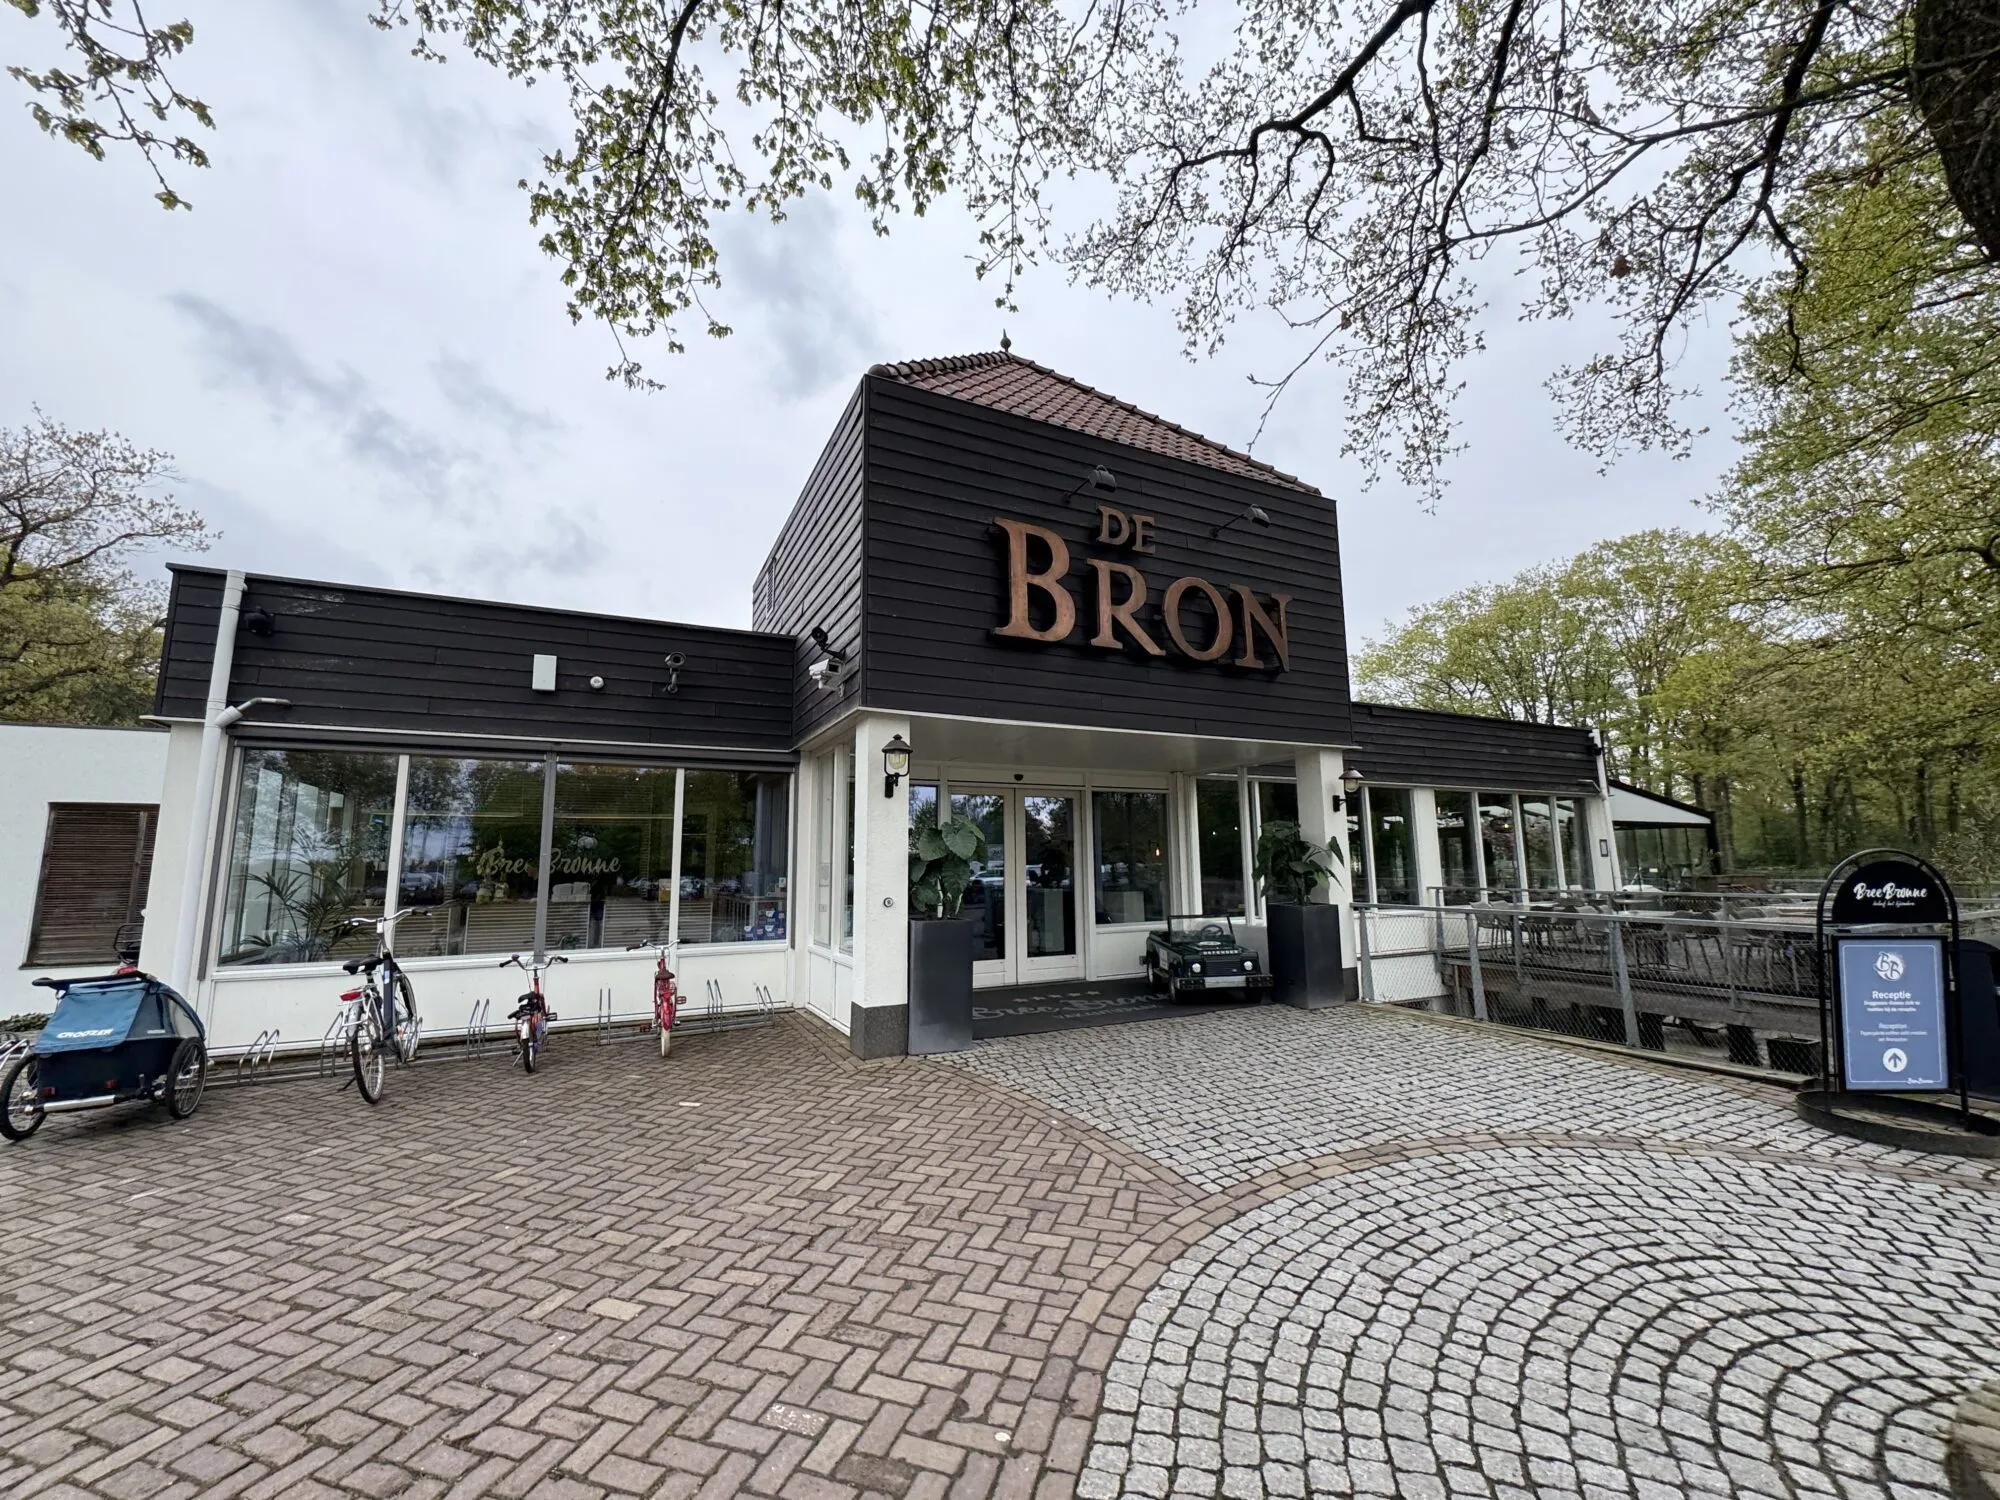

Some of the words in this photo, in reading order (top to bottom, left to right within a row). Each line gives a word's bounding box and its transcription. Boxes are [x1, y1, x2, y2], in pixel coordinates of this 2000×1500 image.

[1096, 504, 1156, 554] DE
[992, 515, 1294, 673] BRON
[1872, 990, 1912, 1000] Receptie
